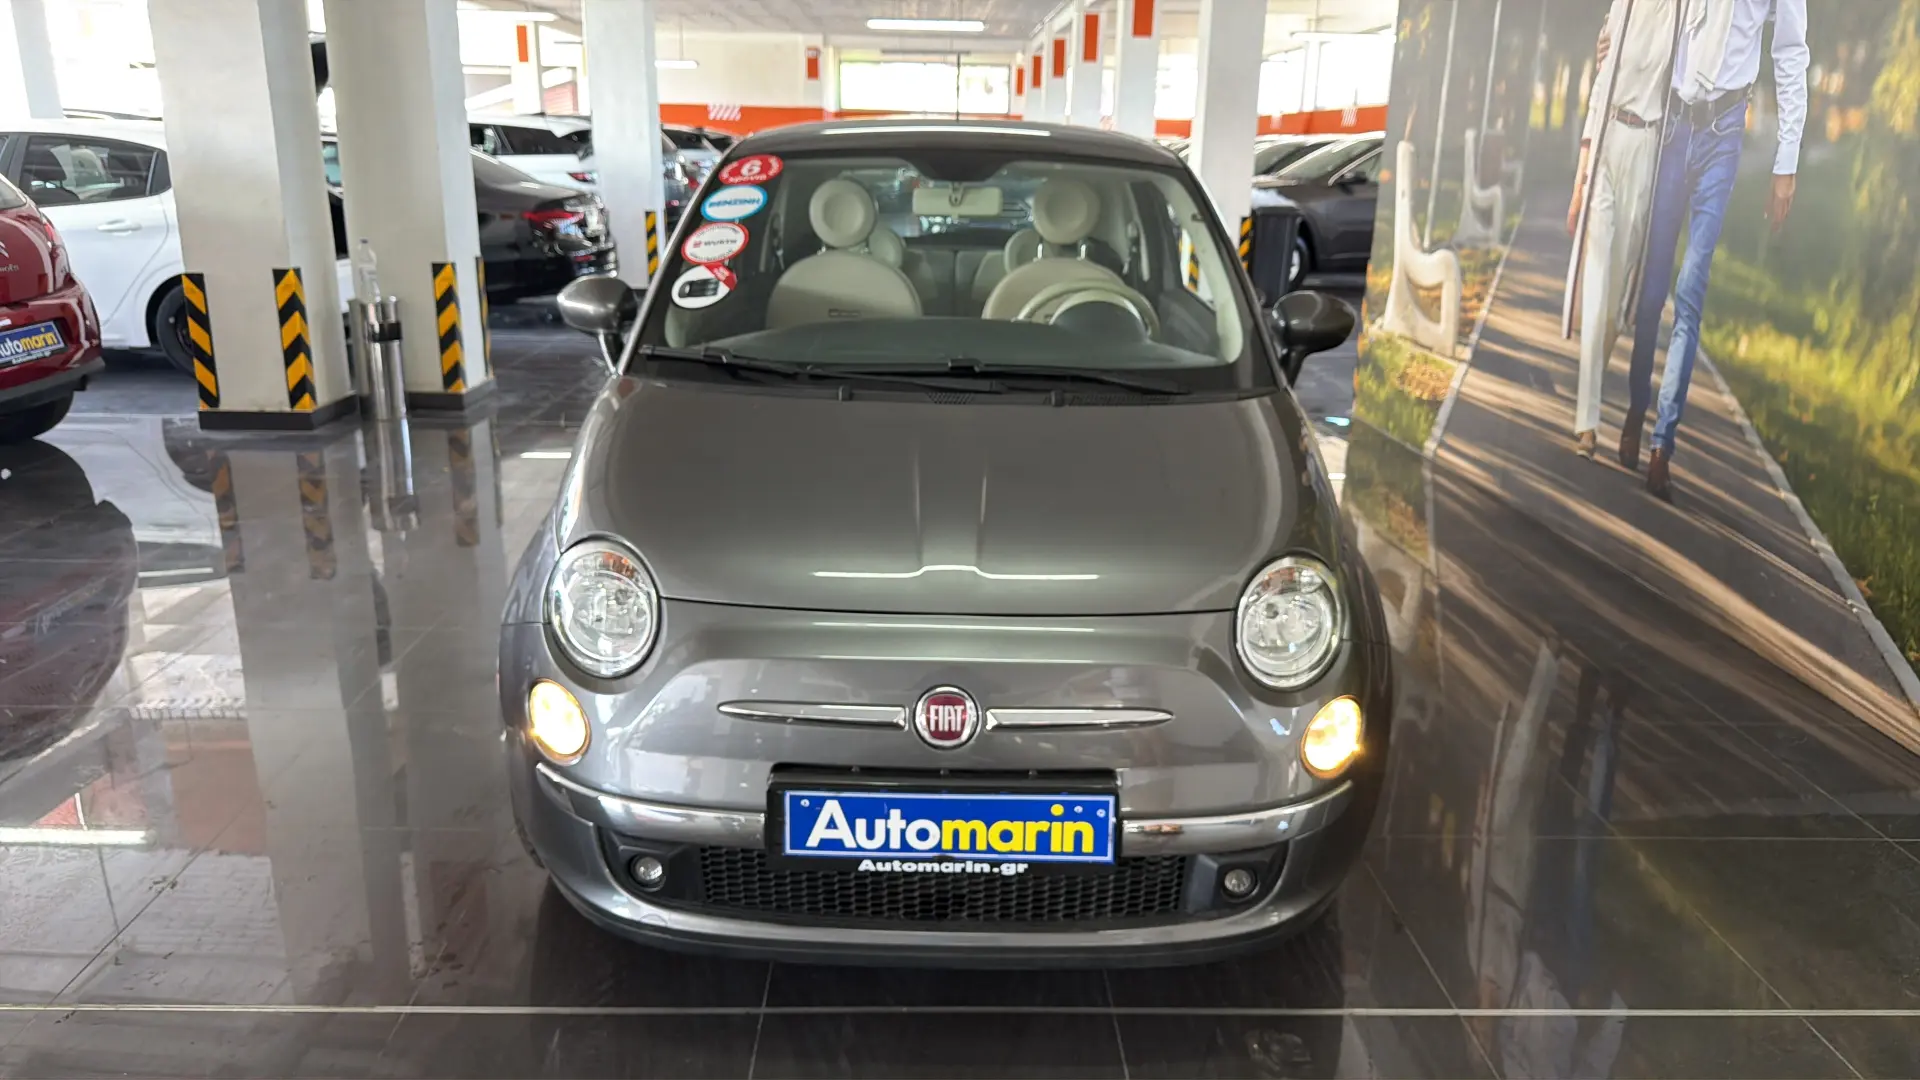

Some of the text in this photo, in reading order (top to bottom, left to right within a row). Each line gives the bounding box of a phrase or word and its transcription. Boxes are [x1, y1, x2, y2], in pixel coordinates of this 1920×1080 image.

[740, 159, 763, 177] 6
[929, 704, 966, 732] FIAT
[805, 799, 1094, 854] Automarin
[857, 858, 1029, 875] Automarin.gr
